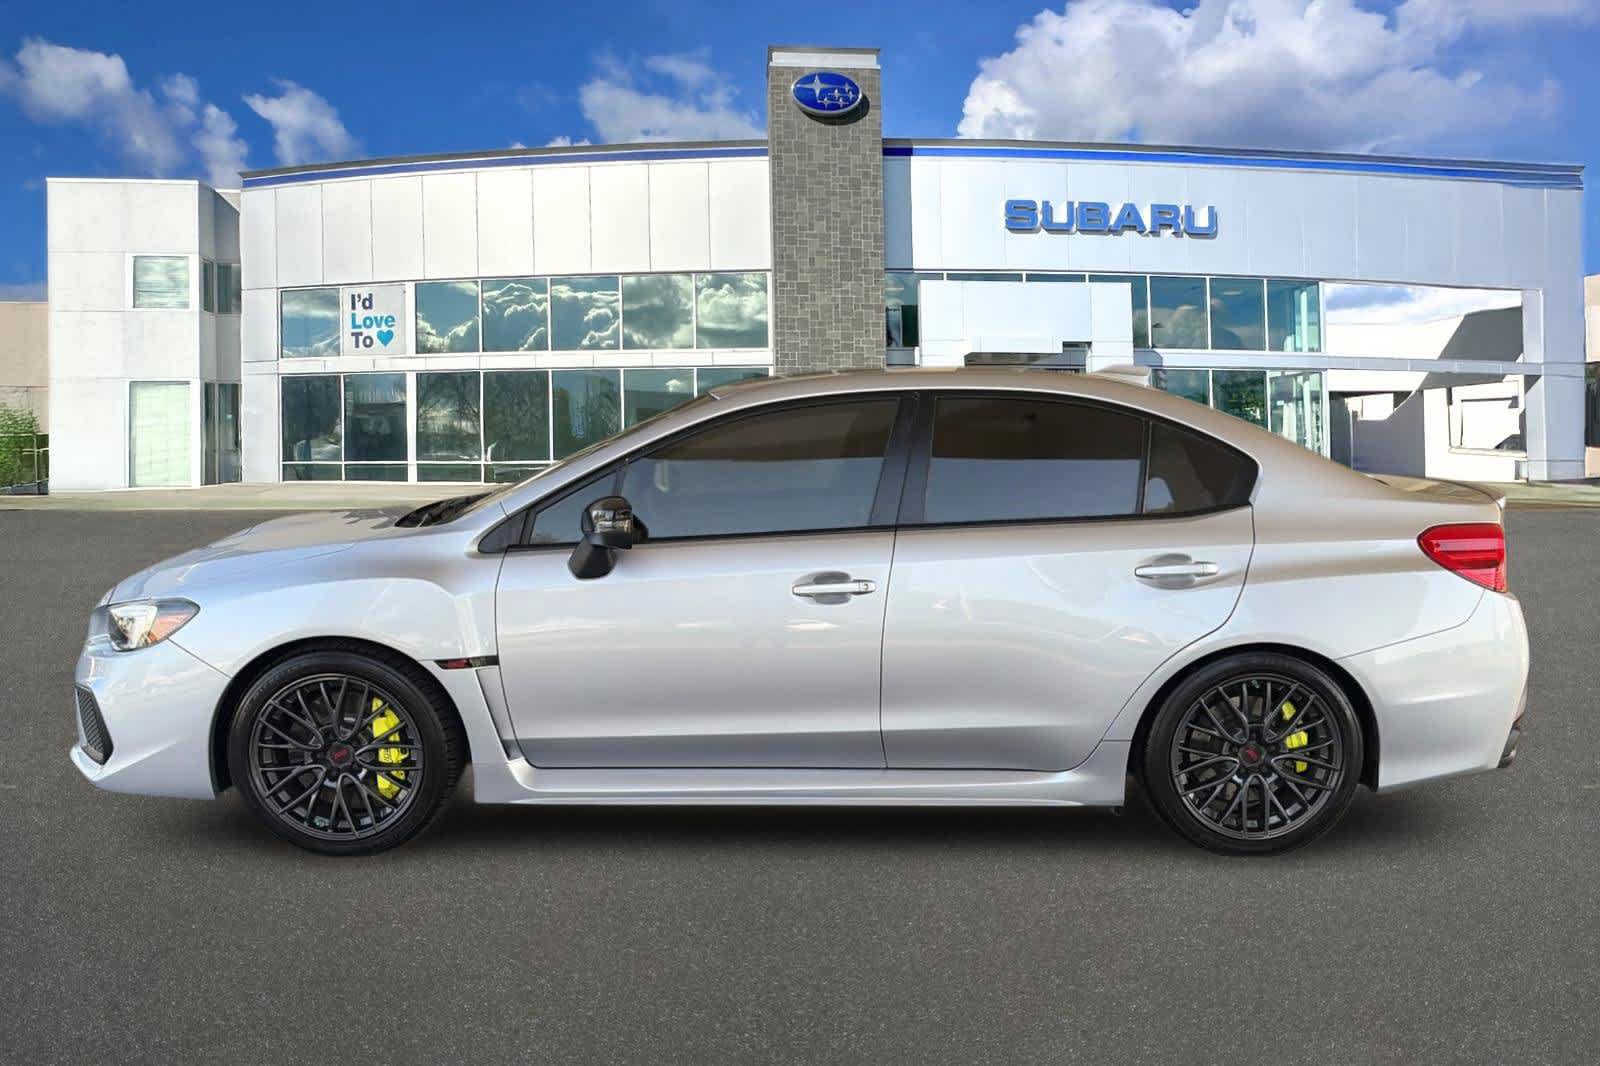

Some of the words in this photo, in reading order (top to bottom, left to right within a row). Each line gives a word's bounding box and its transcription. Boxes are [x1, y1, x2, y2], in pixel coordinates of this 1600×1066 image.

[1005, 199, 1218, 239] SUBARU
[351, 312, 396, 329] Love
[351, 331, 374, 348] To
